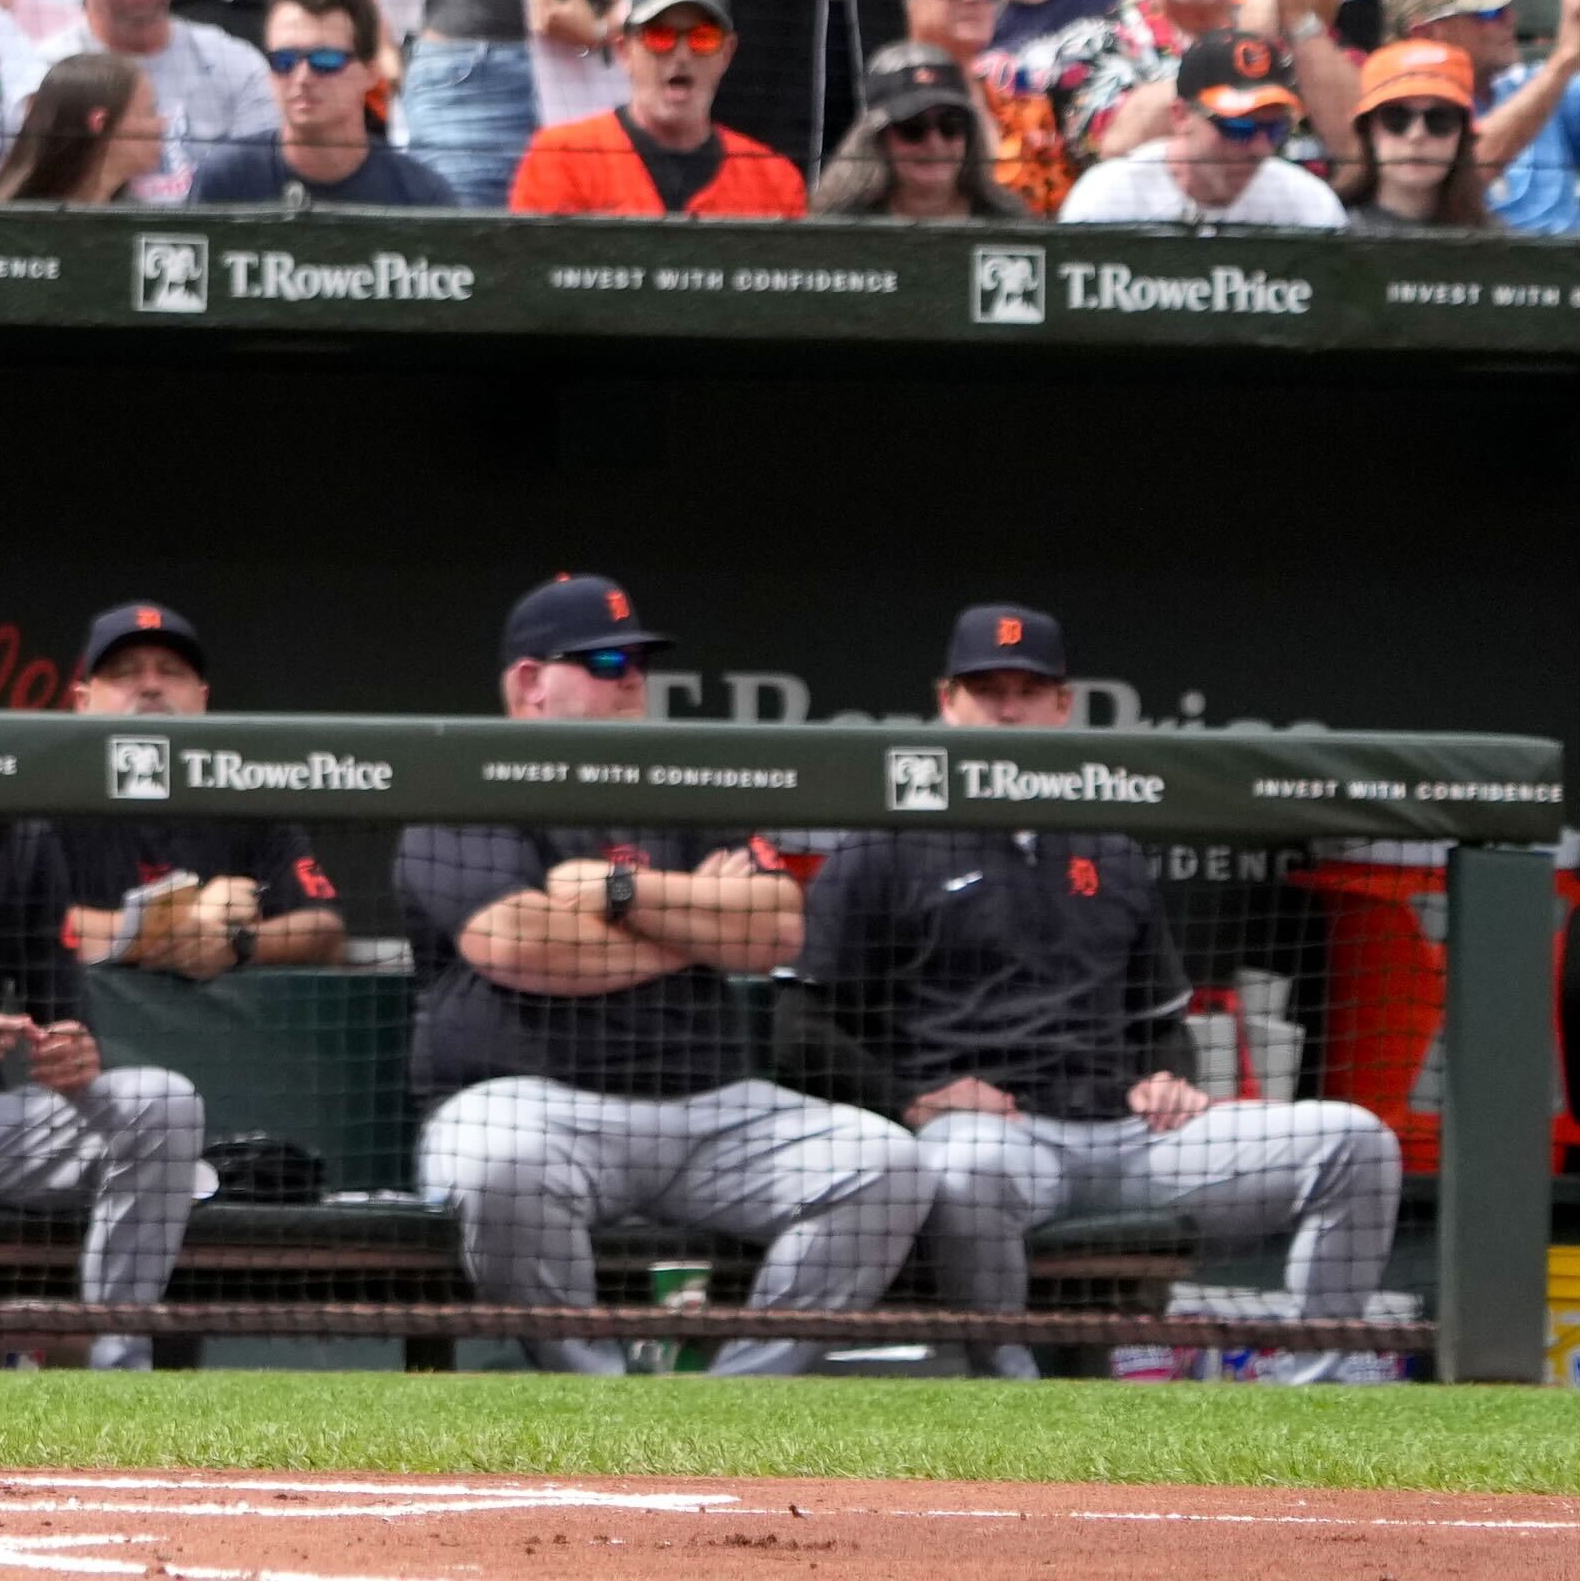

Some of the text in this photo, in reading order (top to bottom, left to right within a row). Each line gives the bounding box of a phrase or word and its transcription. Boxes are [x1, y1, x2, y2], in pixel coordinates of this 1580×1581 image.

[550, 266, 898, 293] INVEST WITH CONFIDENCE
[1386, 282, 1482, 305] INVEST
[1491, 285, 1561, 306] WITH
[482, 762, 798, 789] INVEST WITH CONFIDENCE
[1252, 778, 1563, 803] INVEST WITH CONFIDENCE
